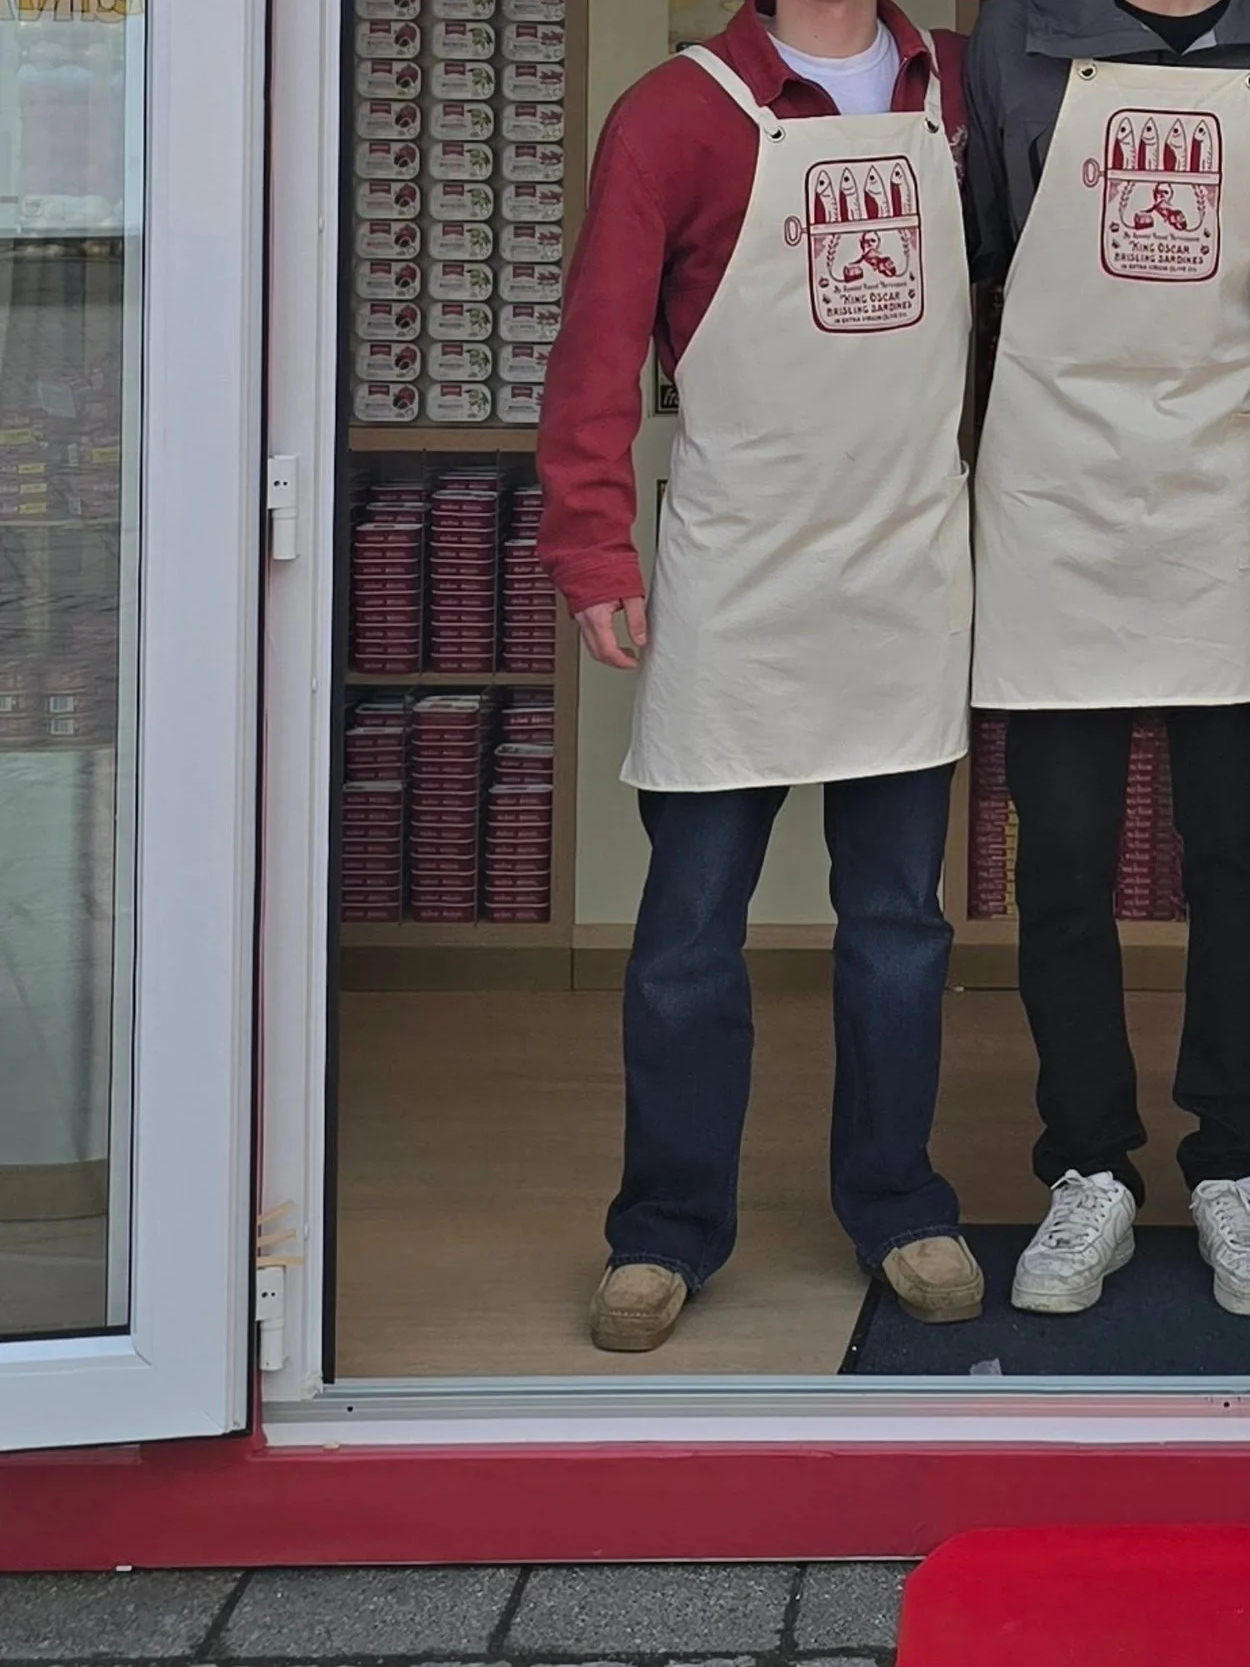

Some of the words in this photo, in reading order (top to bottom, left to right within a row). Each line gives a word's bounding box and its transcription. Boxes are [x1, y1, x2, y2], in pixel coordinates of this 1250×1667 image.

[1157, 241, 1191, 255] OSCAR
[1157, 254, 1204, 265] SARDINES
[839, 294, 868, 305] KING
[869, 292, 901, 303] OSCAR
[871, 300, 913, 313] SARDINES
